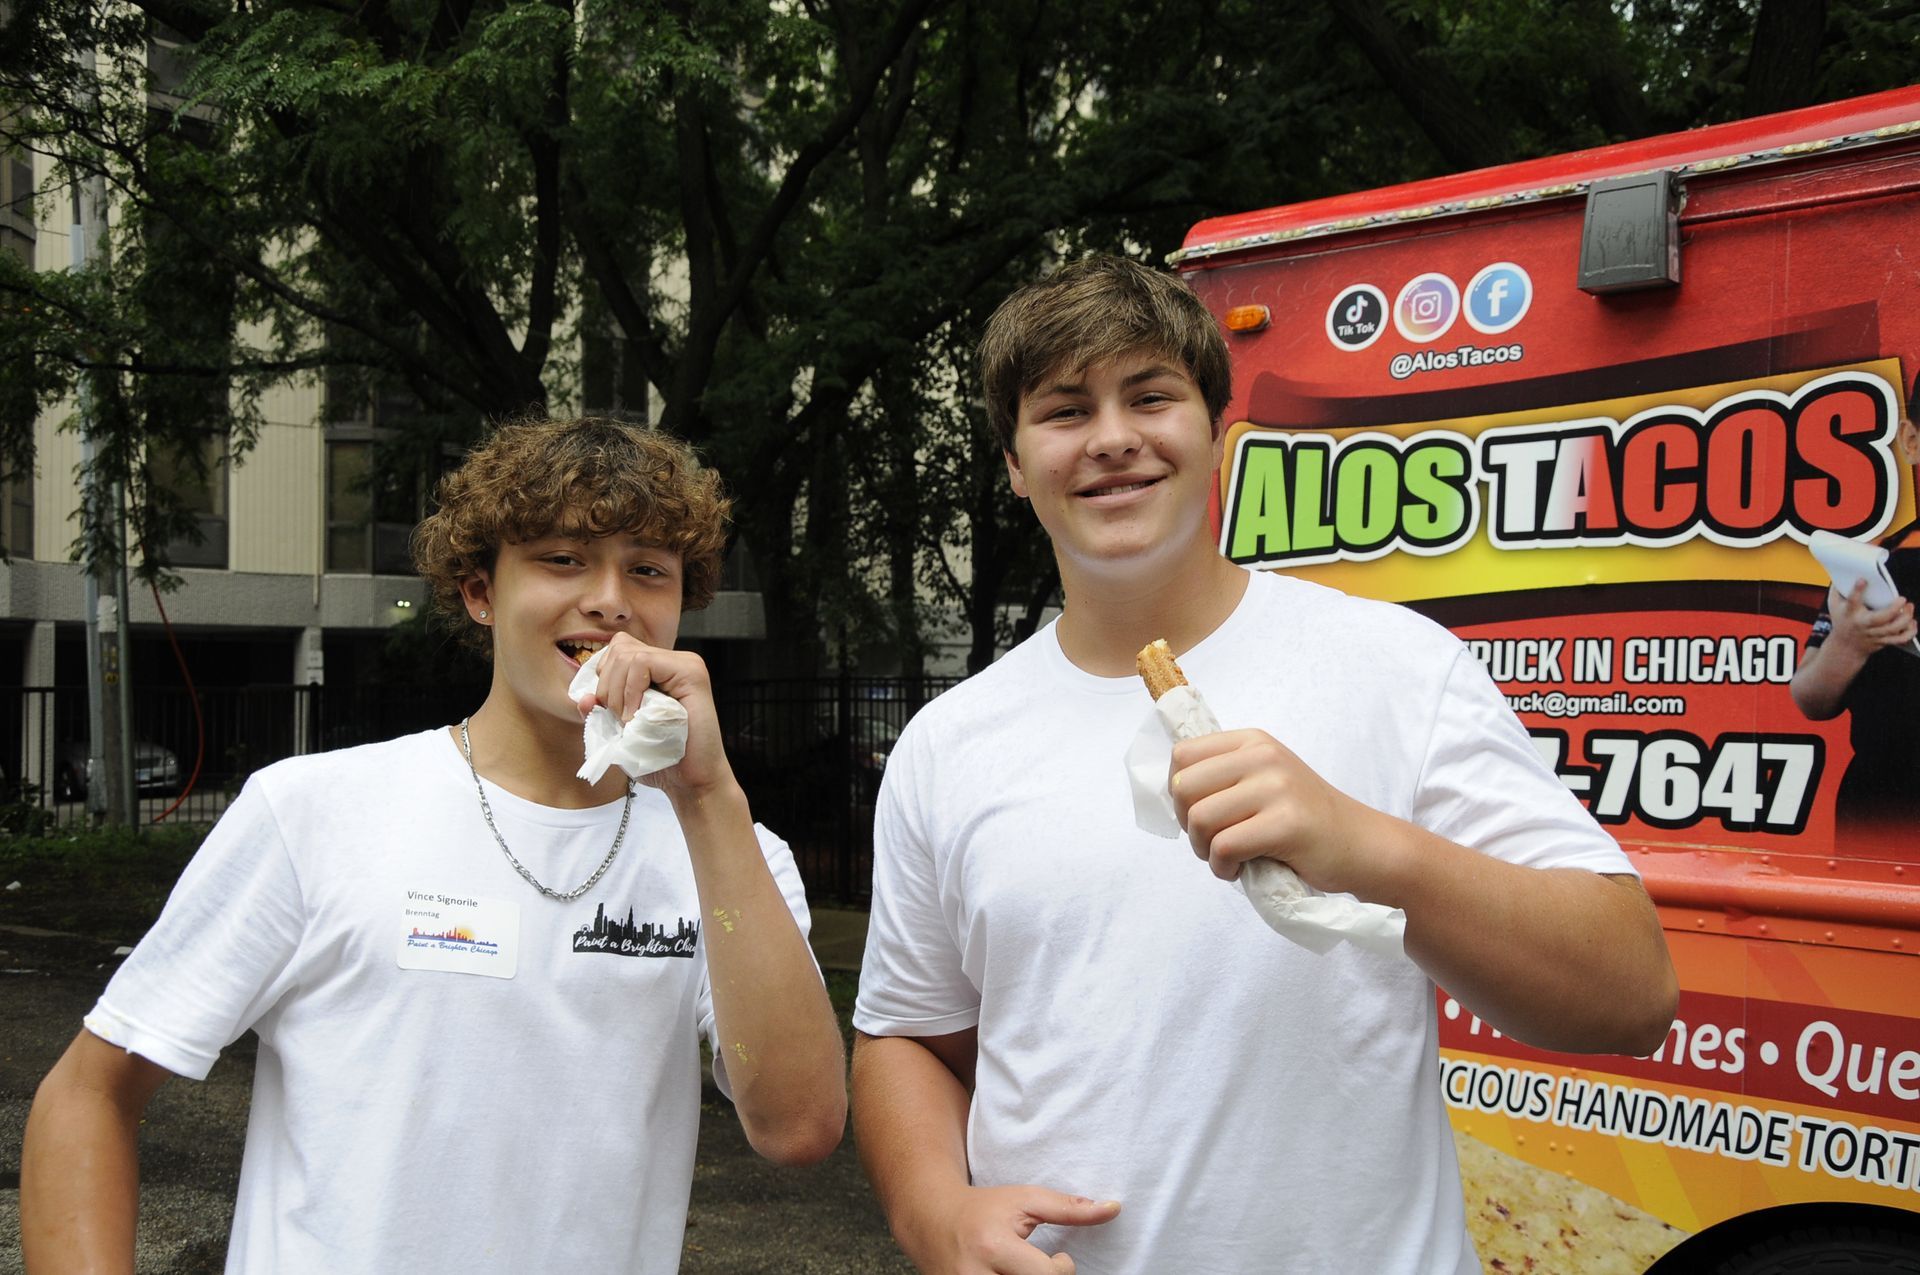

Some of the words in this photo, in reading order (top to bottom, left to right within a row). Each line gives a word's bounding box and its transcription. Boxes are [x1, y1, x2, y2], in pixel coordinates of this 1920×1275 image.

[1338, 325, 1353, 337] Tik
[1357, 322, 1375, 334] Tok
[1390, 345, 1522, 377] @AlosTacos
[1227, 439, 1470, 564] ALOS
[1485, 386, 1885, 538] TACOS
[1464, 639, 1564, 682] RUCK
[1573, 638, 1612, 682] IN
[1624, 637, 1796, 682] CHICAGO
[407, 891, 435, 902] Vince
[437, 895, 478, 907] Signorile
[405, 909, 440, 919] Brenntag
[407, 939, 429, 948] Paint
[438, 942, 467, 952] Brighter
[470, 945, 498, 956] Chicago
[574, 935, 609, 949] Paint
[610, 940, 618, 949] a
[621, 937, 672, 957] Brighter
[1796, 1020, 1920, 1101] Que
[1556, 1080, 1790, 1162] HANDMADE
[1801, 1121, 1920, 1188] TORT
